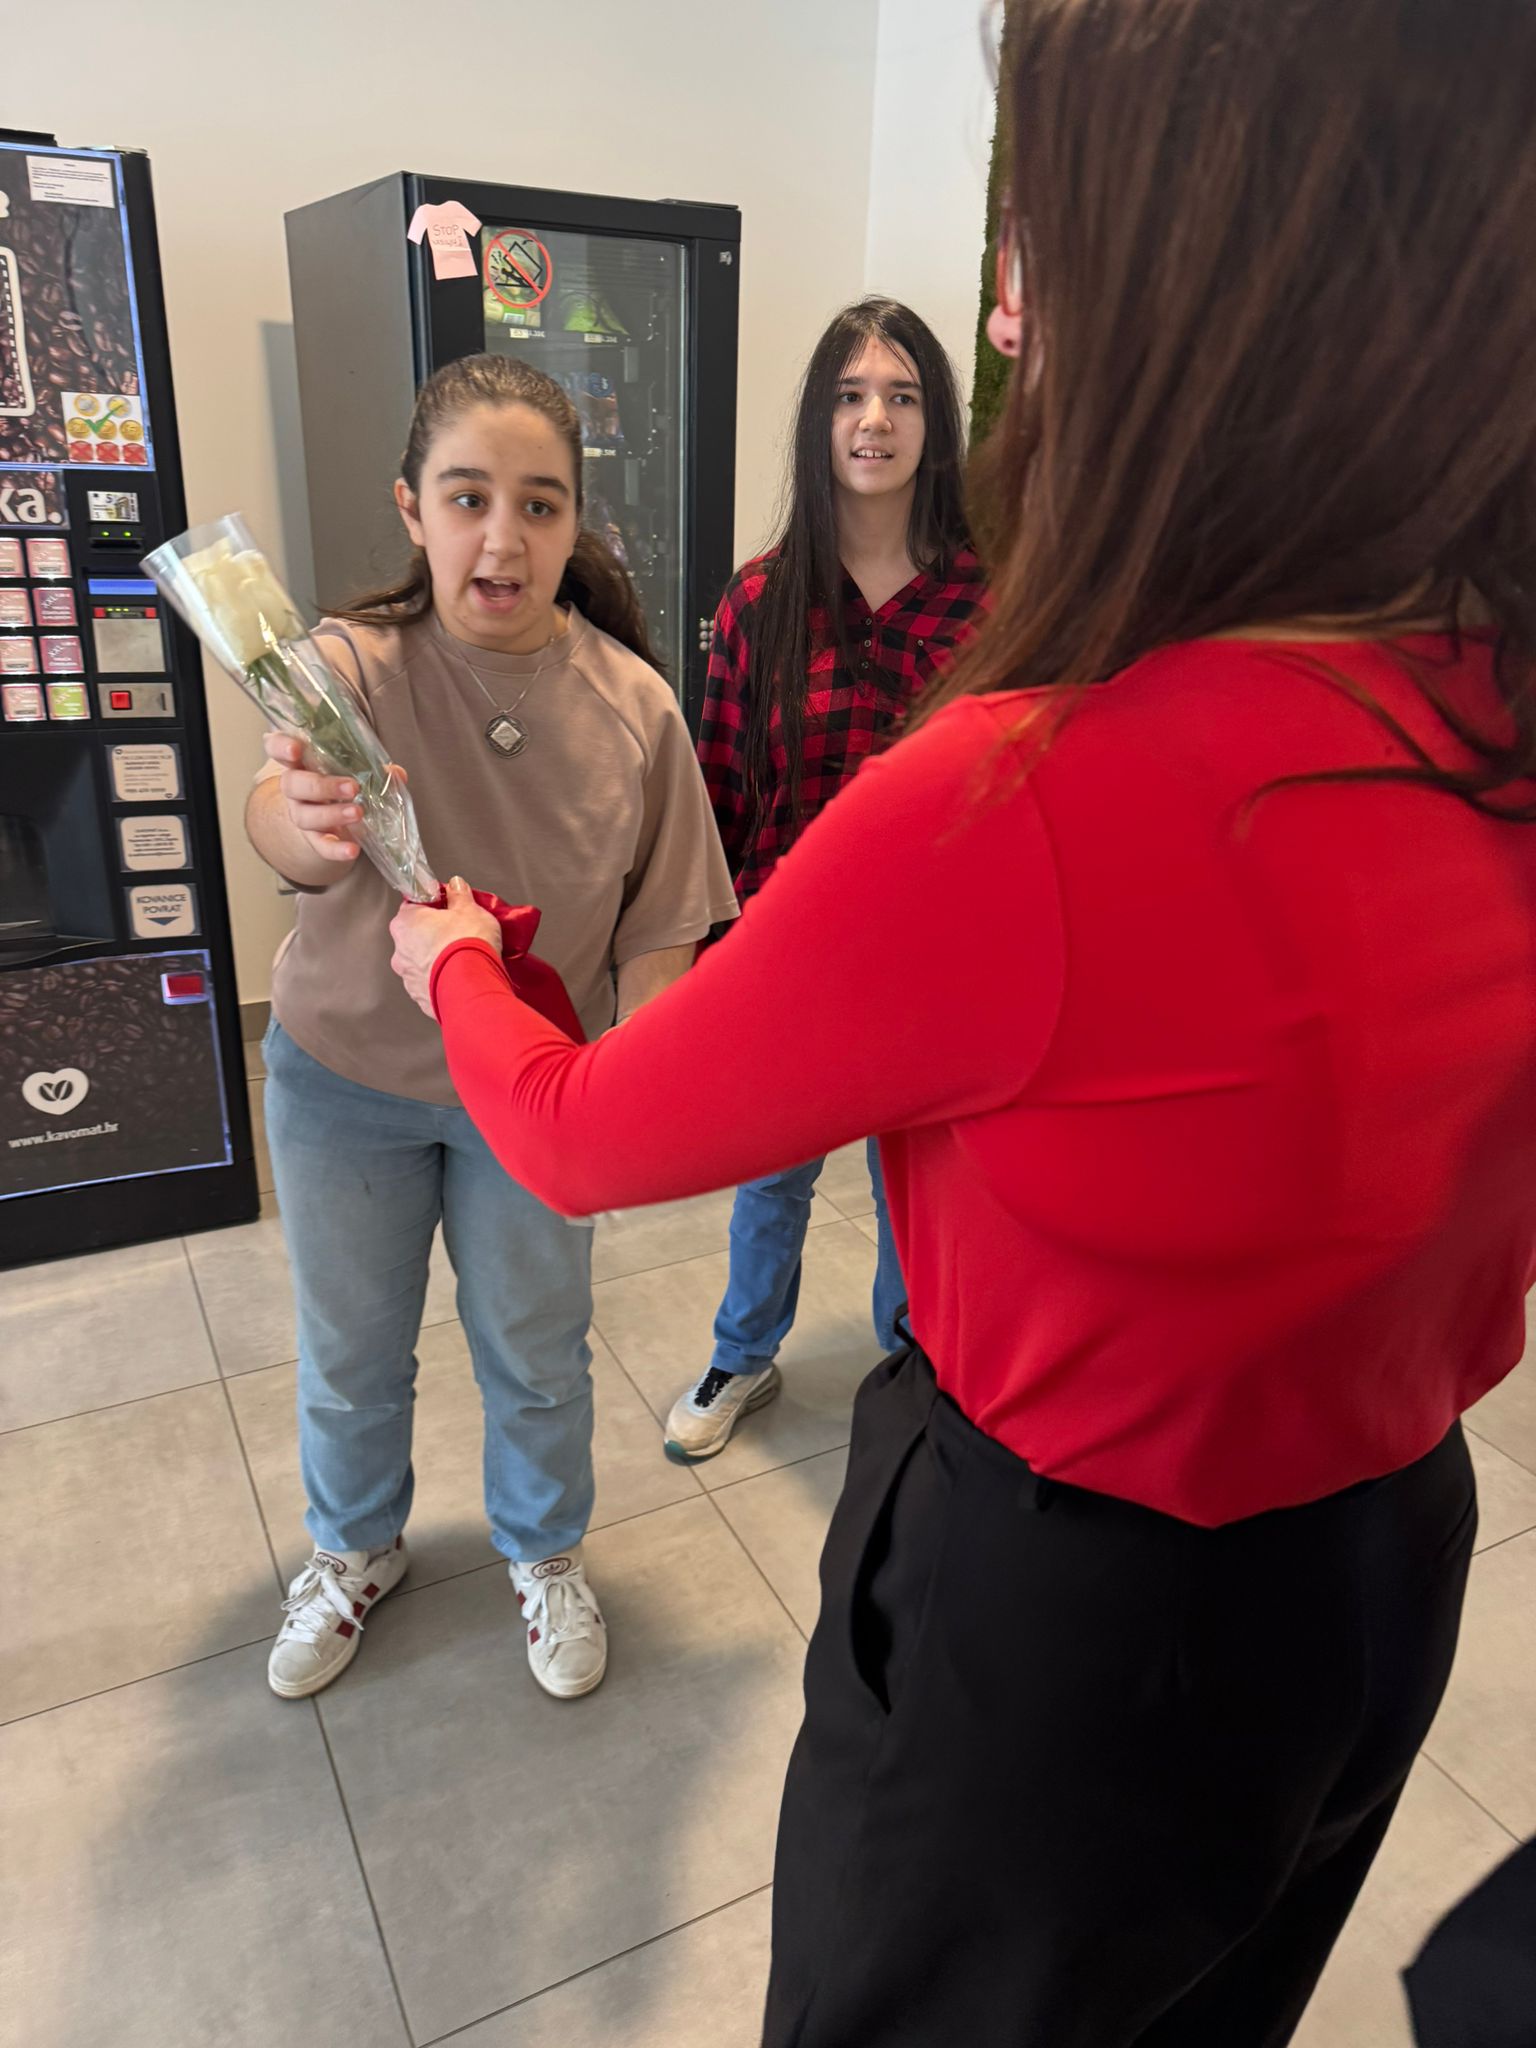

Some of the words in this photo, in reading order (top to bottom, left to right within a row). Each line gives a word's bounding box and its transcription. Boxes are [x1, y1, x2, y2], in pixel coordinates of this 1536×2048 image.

[433, 224, 459, 236] STOP
[136, 894, 186, 904] KOVANICE
[143, 904, 181, 914] POVRAT
[8, 1121, 119, 1148] www.kavomat.hr
